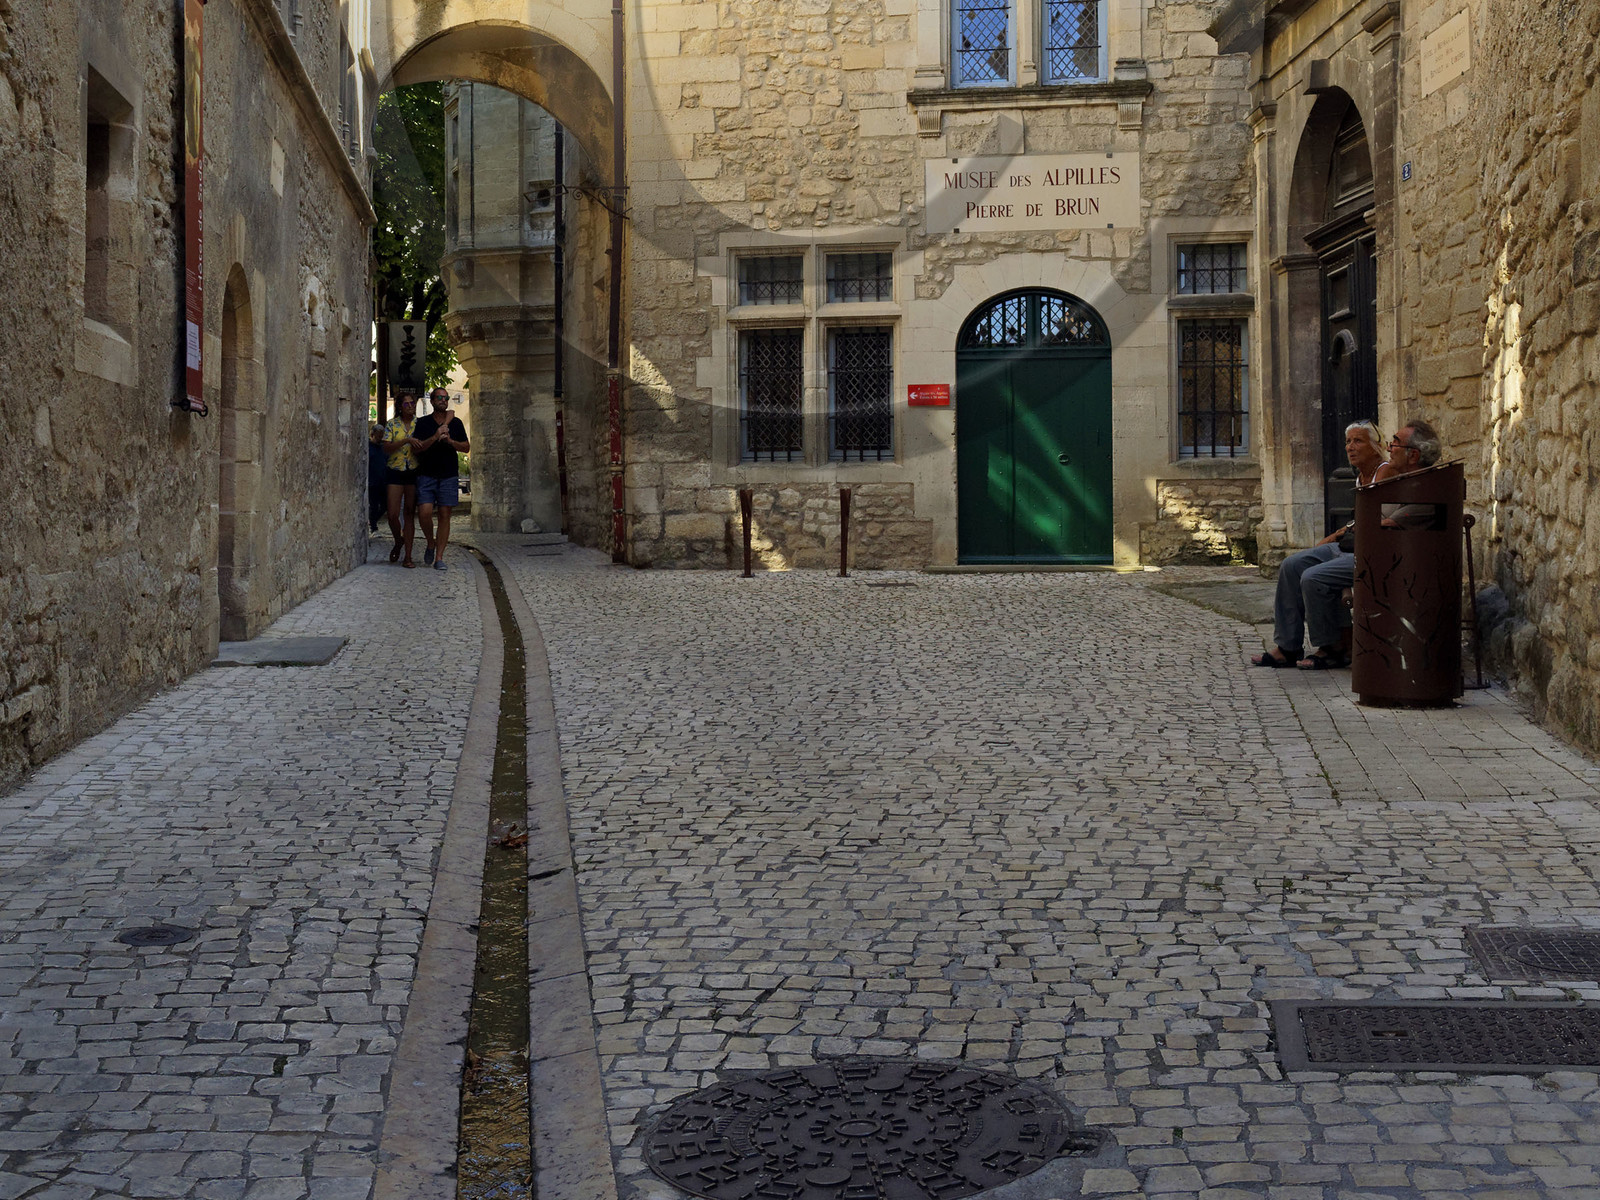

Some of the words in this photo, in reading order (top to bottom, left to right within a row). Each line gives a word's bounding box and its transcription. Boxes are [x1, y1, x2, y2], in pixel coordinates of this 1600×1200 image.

[944, 171, 999, 189] MUSEE
[1009, 175, 1032, 187] DES
[1042, 167, 1121, 186] ALPILLES
[966, 201, 1014, 218] PIERRE
[1025, 203, 1043, 217] DE
[1055, 197, 1100, 216] BRUN
[197, 209, 203, 231] de
